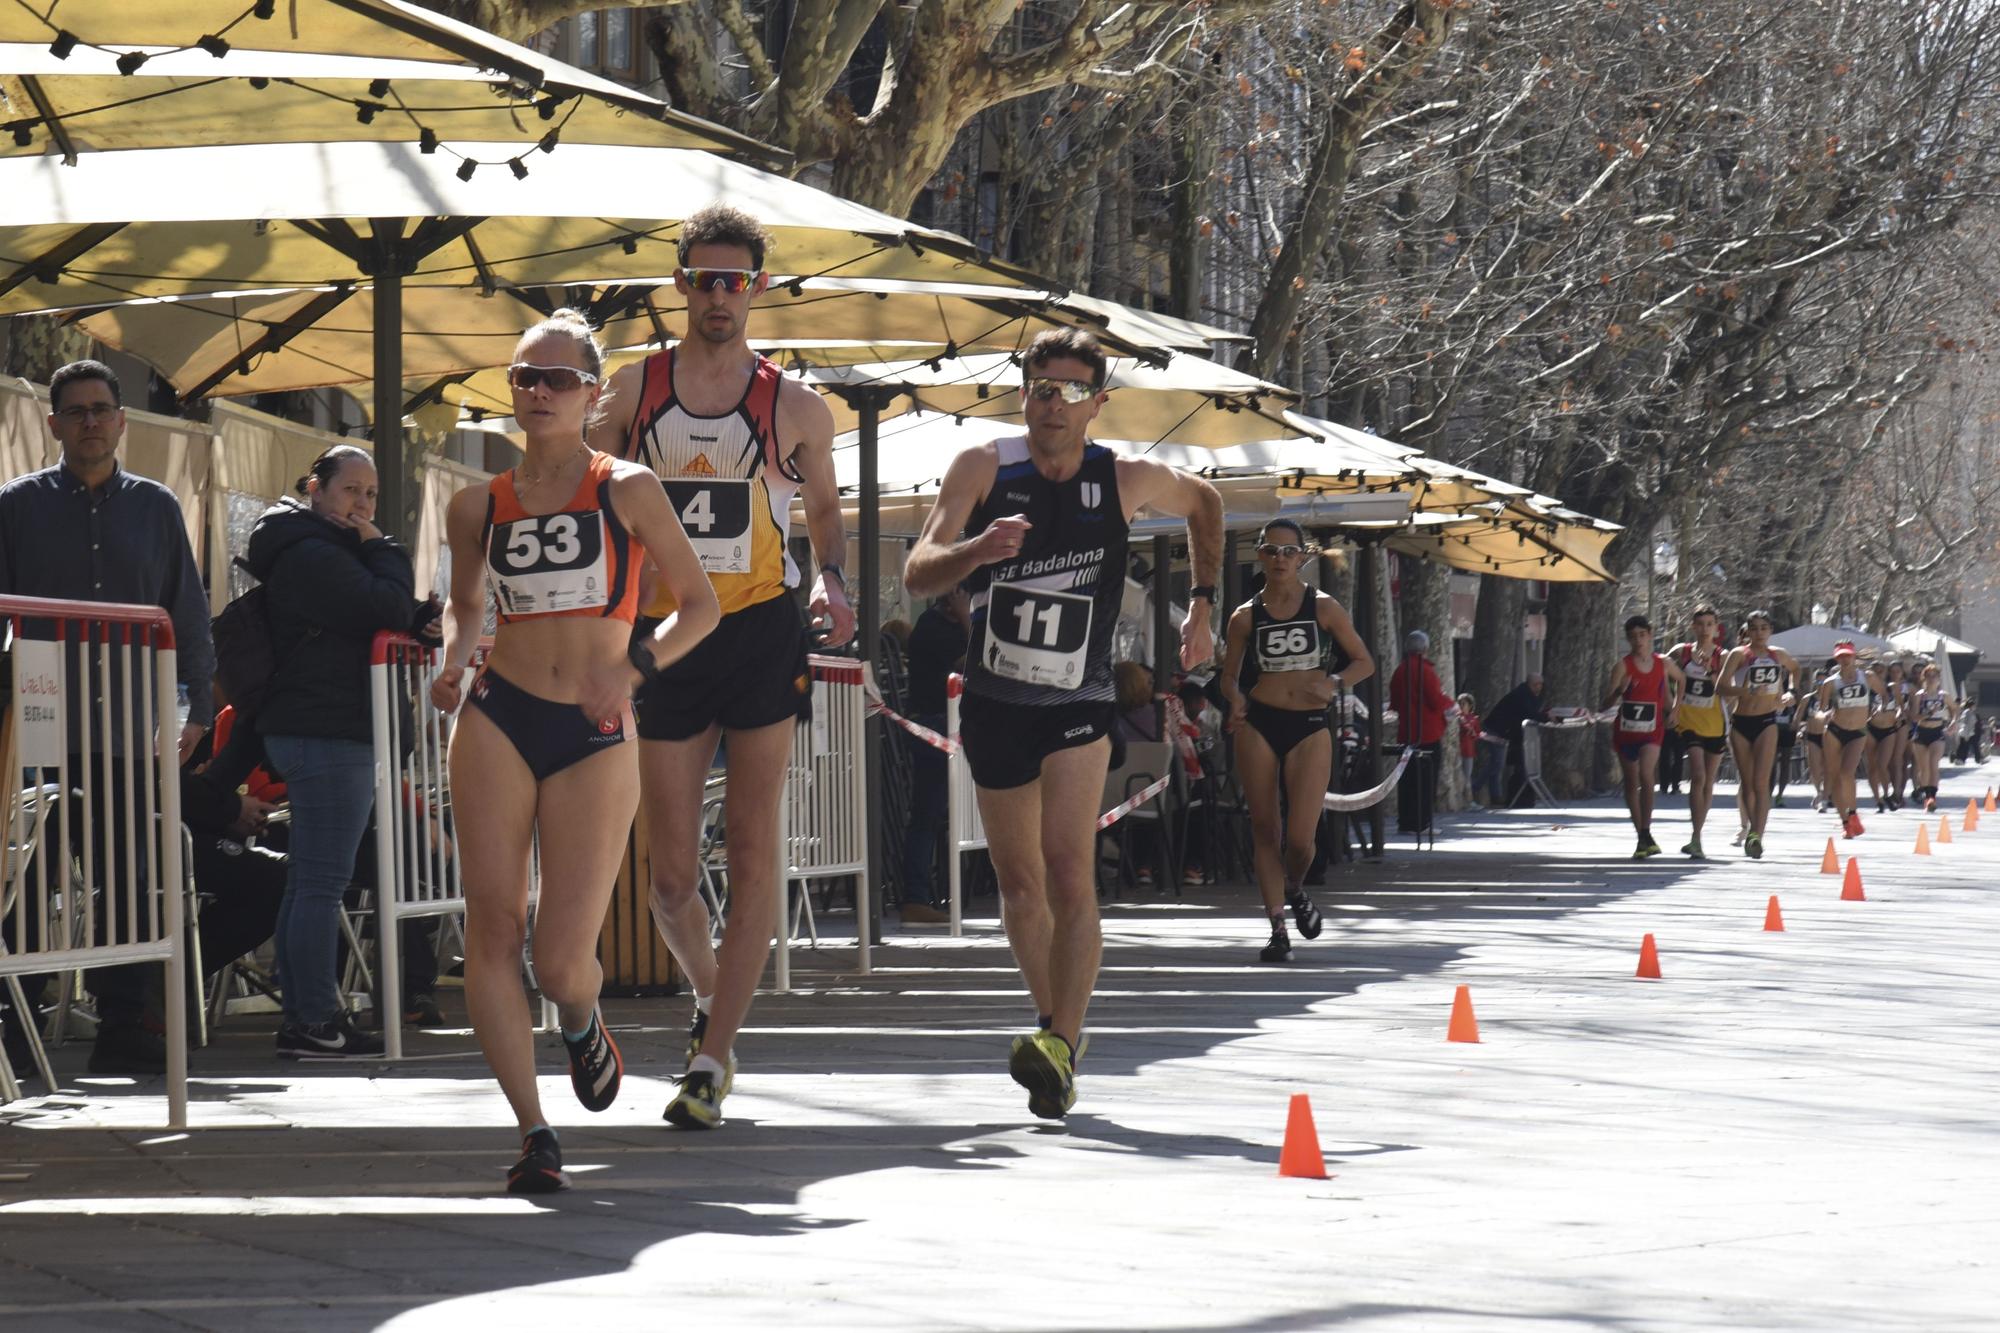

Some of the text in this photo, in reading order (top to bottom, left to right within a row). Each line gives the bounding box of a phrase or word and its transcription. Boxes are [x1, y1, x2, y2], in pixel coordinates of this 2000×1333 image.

[682, 491, 715, 532] 4
[506, 514, 581, 568] 53
[1021, 547, 1104, 576] Badalona
[1013, 599, 1062, 646] 11
[1266, 628, 1307, 654] 56
[1692, 681, 1703, 694] 5
[1755, 668, 1776, 682] 54
[1842, 685, 1861, 698] 57
[1633, 706, 1644, 719] 7
